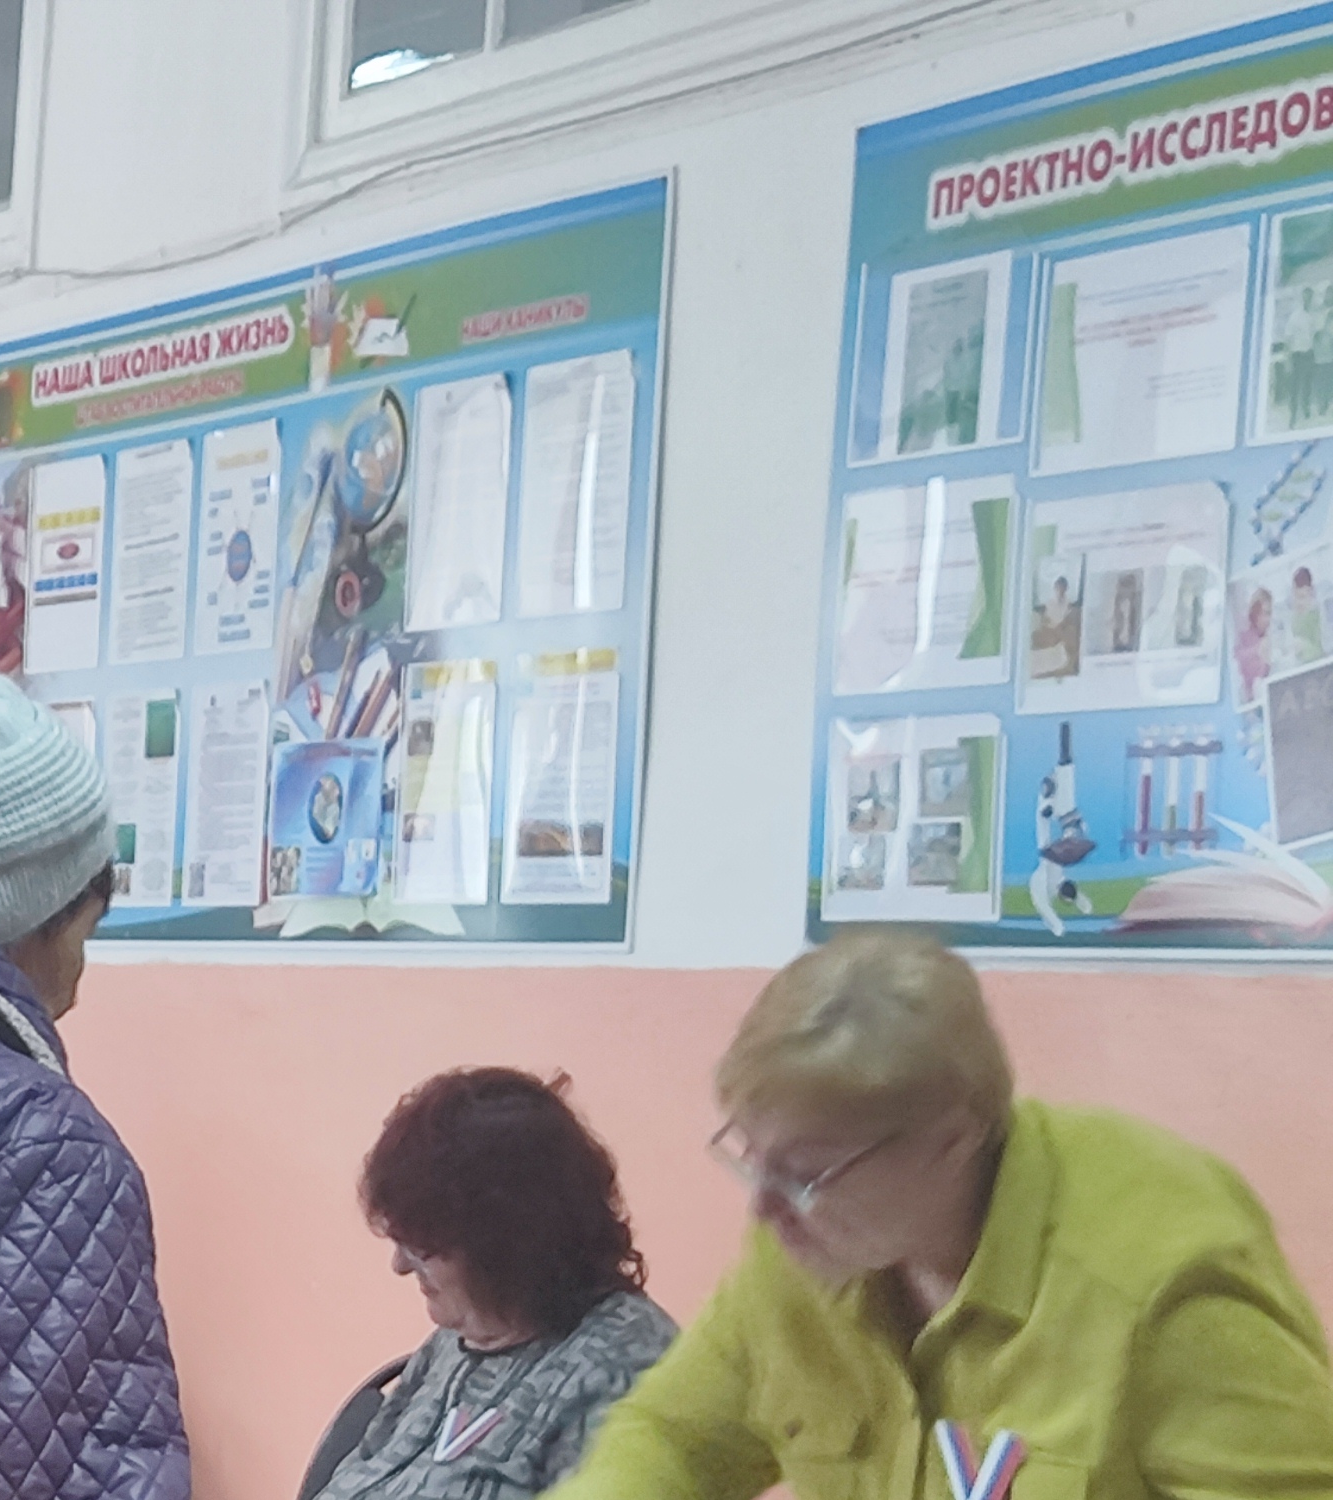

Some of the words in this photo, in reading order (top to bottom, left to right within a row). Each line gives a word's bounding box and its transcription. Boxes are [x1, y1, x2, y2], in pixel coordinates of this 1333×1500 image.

[34, 359, 94, 399] НАША
[98, 331, 211, 385] ШКОЛЬНАЯ
[216, 314, 289, 359] ЖИЗНЬ
